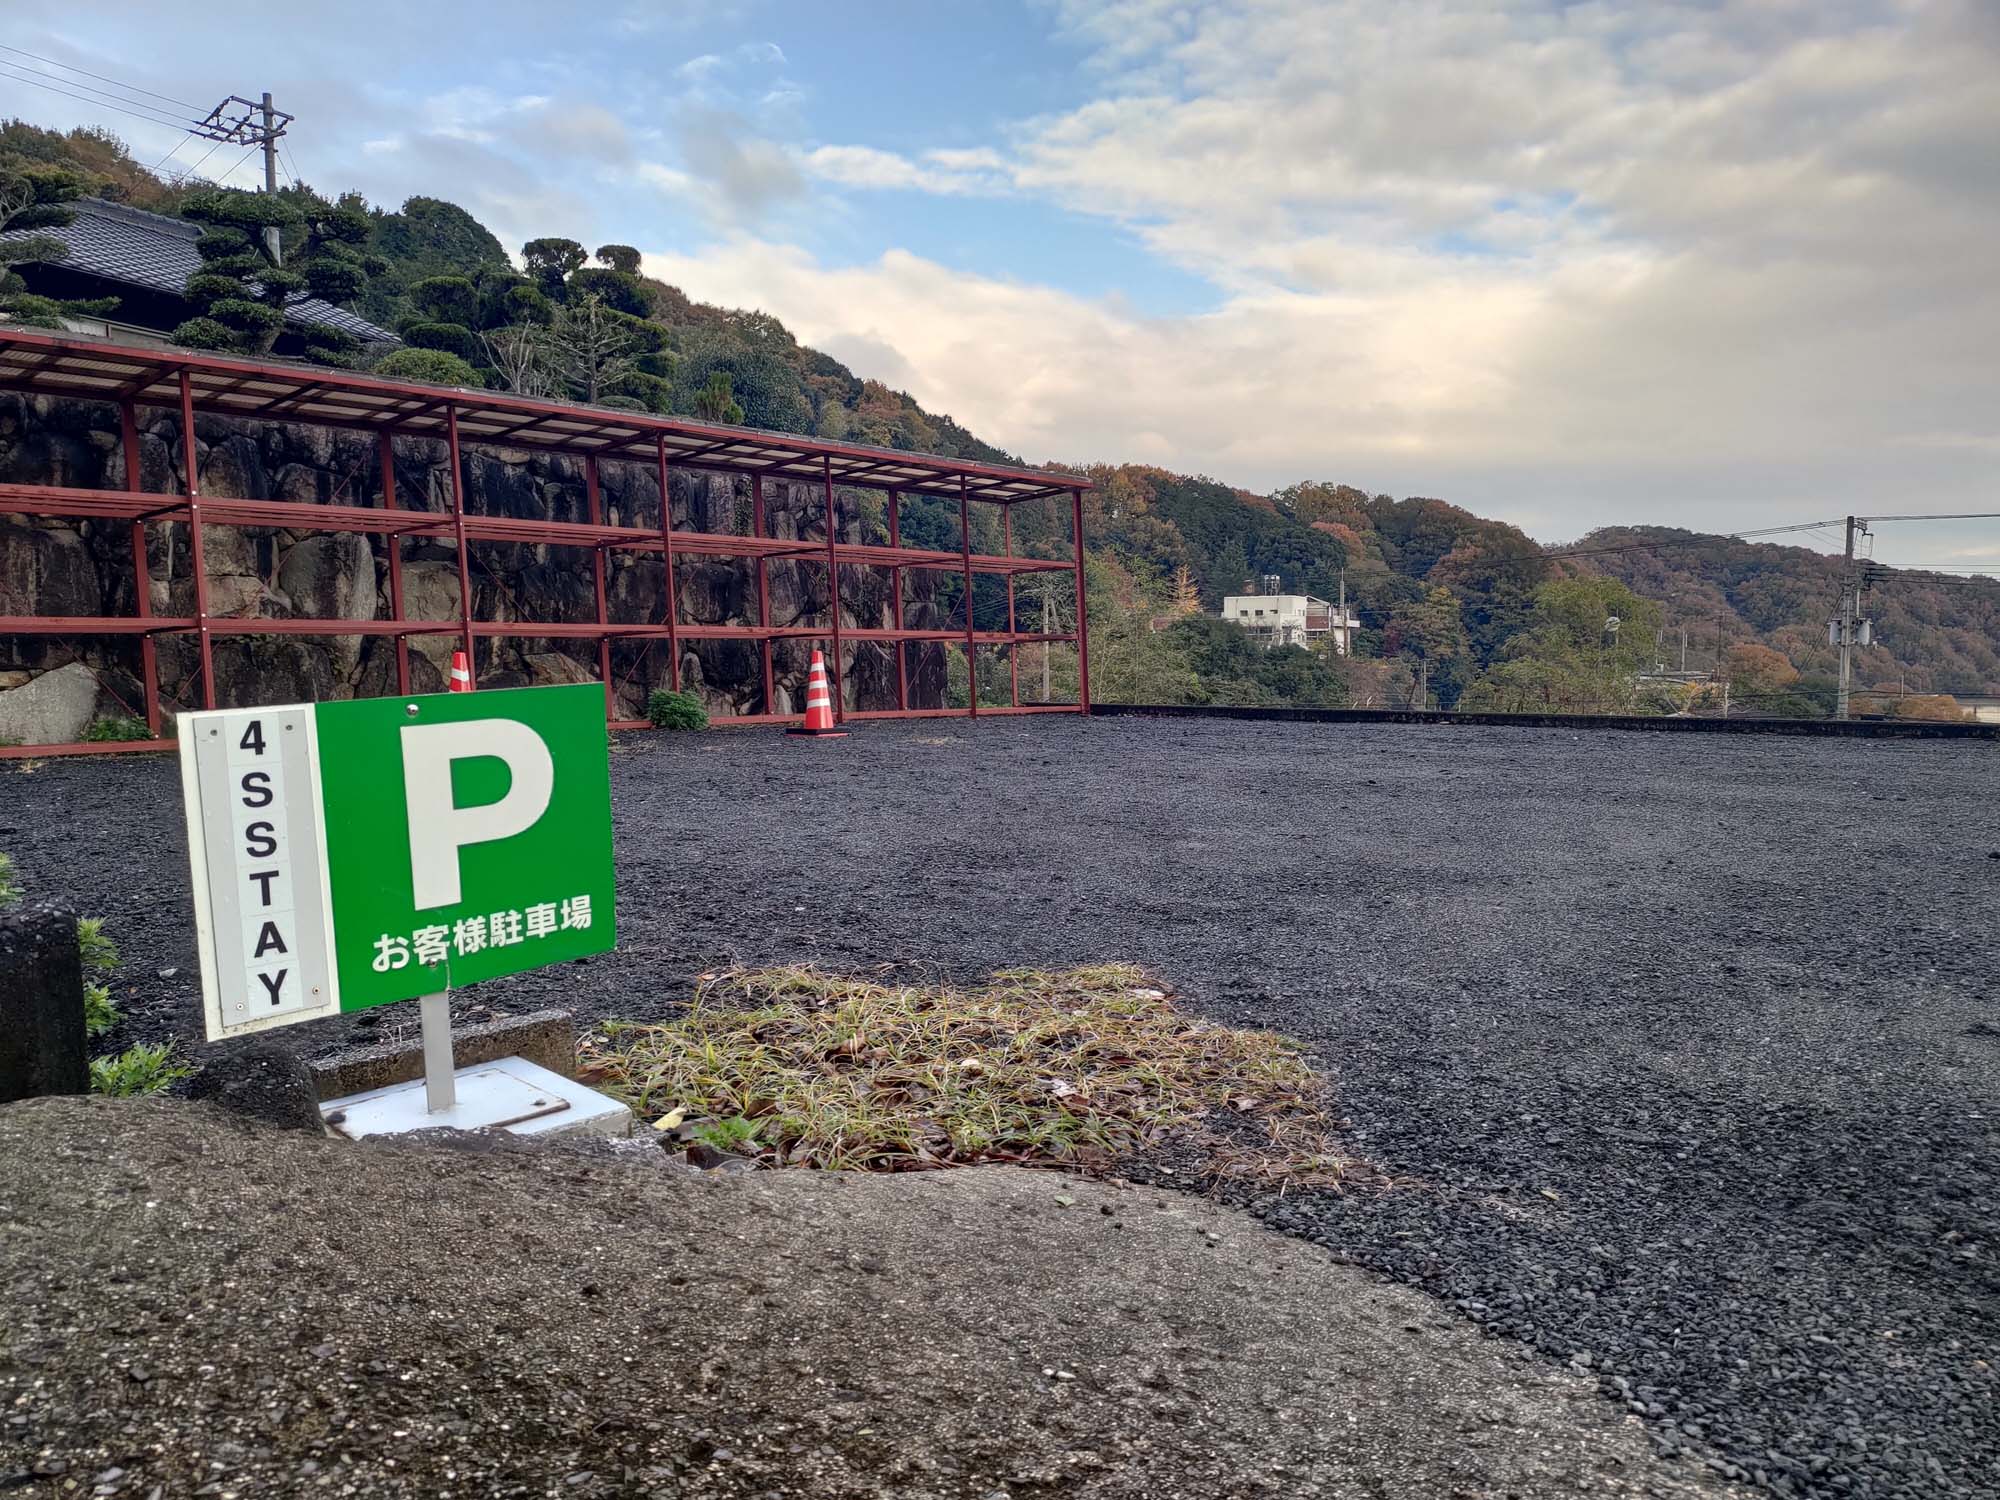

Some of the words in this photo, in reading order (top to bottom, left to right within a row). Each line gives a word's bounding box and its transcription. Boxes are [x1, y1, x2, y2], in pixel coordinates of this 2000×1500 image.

[400, 718, 554, 911] P
[371, 895, 592, 973] お客様駐車場
